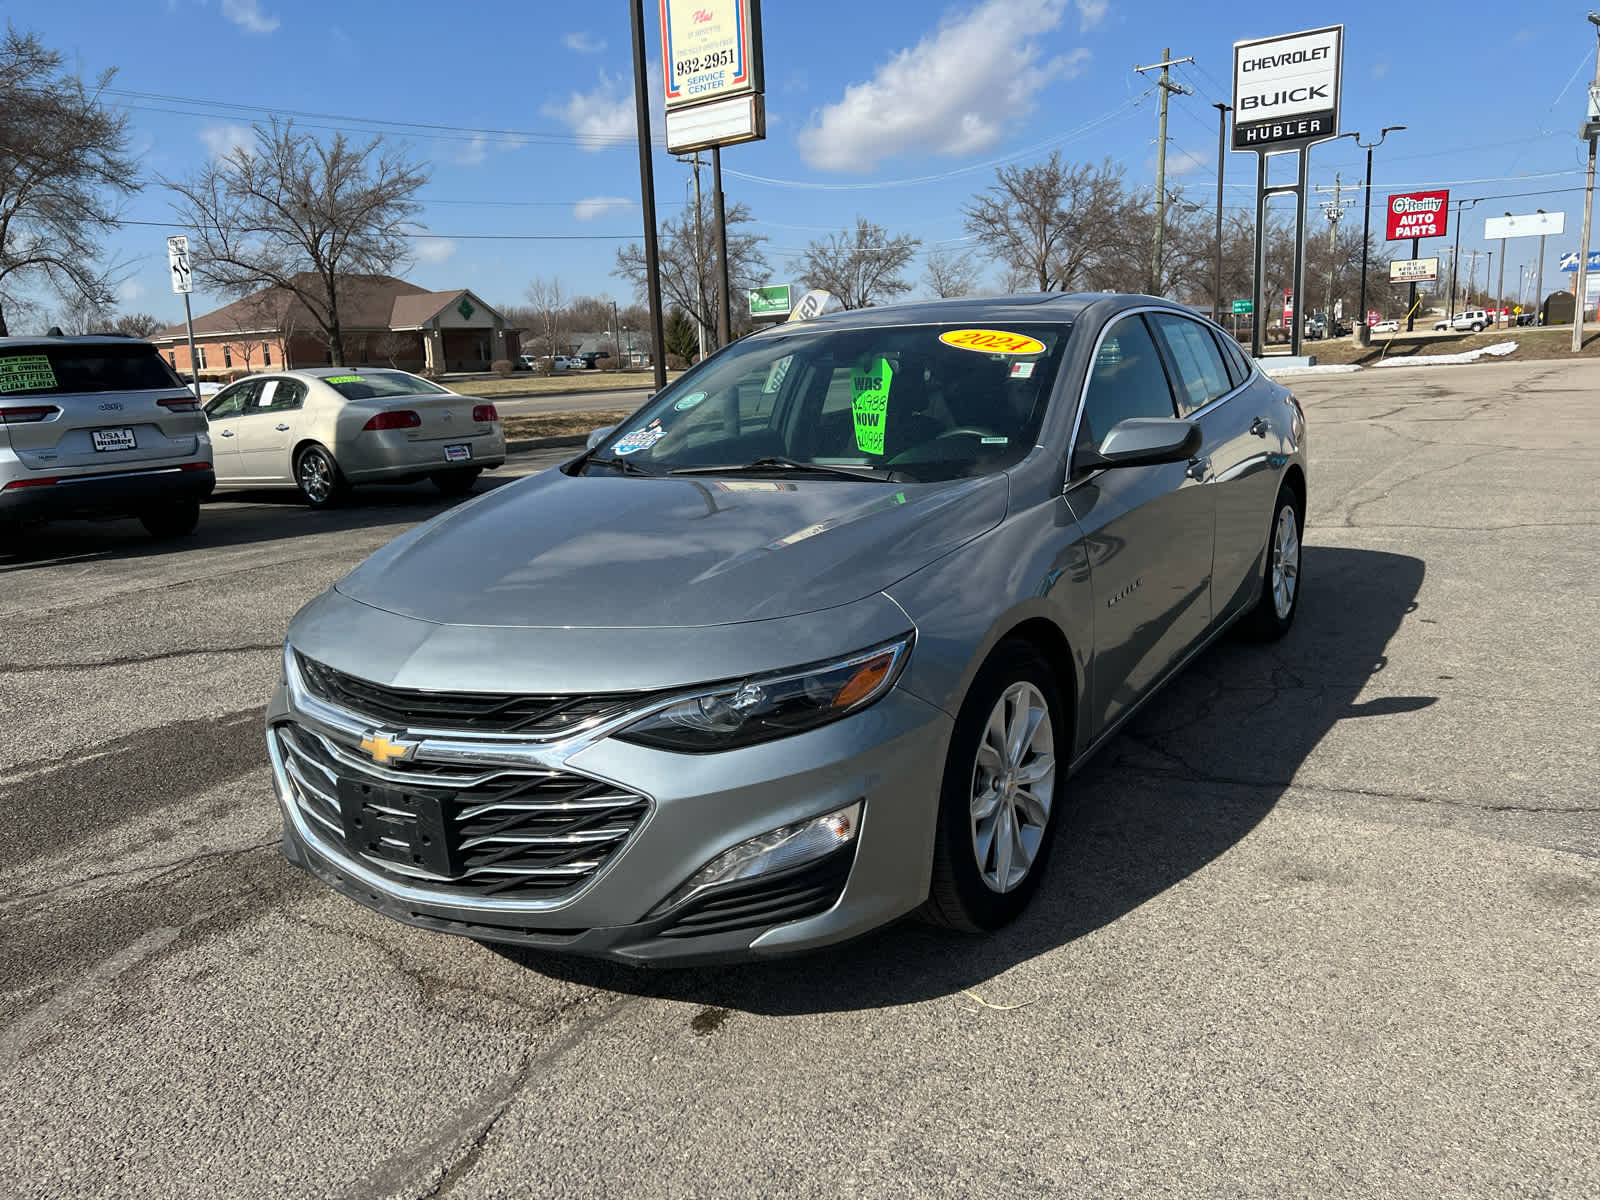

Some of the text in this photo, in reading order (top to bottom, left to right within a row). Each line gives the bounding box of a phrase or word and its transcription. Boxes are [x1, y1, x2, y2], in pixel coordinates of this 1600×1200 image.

[676, 48, 735, 77] 932-2951
[1242, 46, 1331, 72] CHEVROLET
[687, 70, 726, 87] SERVICE
[688, 79, 725, 95] CENTER
[1240, 83, 1329, 111] BUICK
[1246, 120, 1321, 141] HUBLER
[1393, 197, 1442, 214] O'Reilly
[1399, 213, 1434, 226] AUTO
[1395, 224, 1437, 237] PARTS
[951, 333, 1032, 351] 2024
[17, 363, 50, 371] OWNER
[0, 372, 53, 383] CERTIFIED
[854, 376, 883, 391] WAS
[1, 382, 26, 391] CLEAN
[856, 412, 880, 427] NOW
